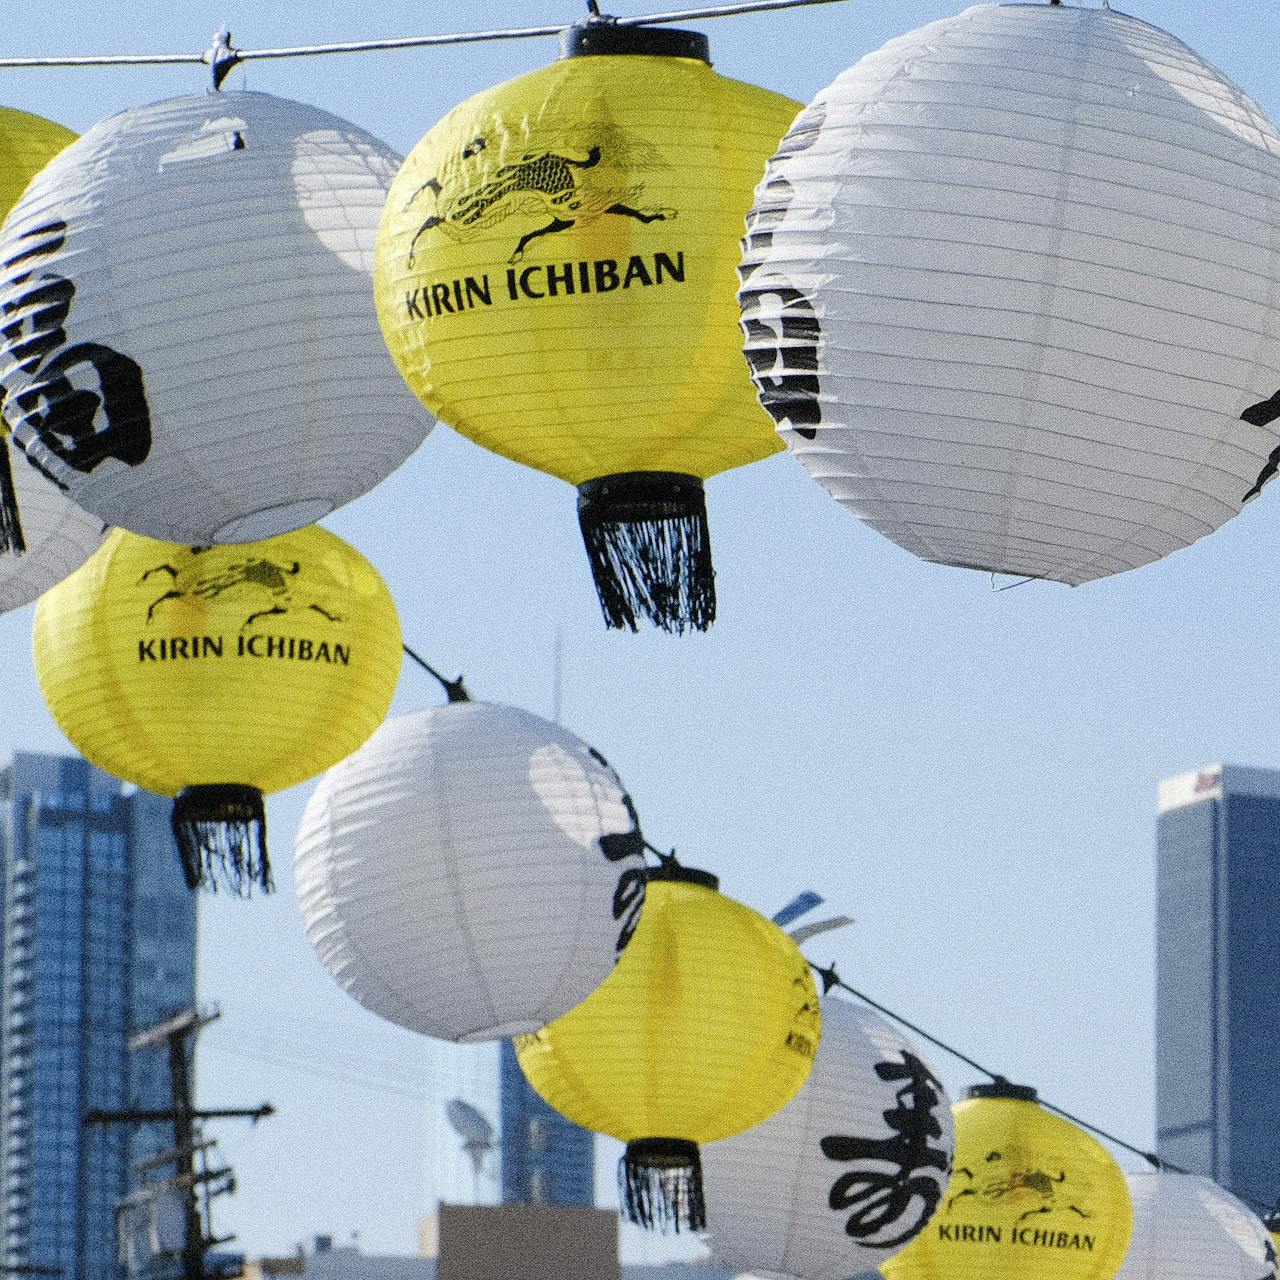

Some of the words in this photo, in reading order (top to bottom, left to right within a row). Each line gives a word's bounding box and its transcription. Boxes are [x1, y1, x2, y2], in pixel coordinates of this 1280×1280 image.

[405, 273, 493, 320] KIRIN
[507, 251, 686, 302] ICHIBAN
[137, 634, 223, 664] KIRIN
[237, 634, 352, 667] ICHIBAN
[937, 1223, 1002, 1245] KIRIN
[1011, 1226, 1096, 1253] ICHIBAN
